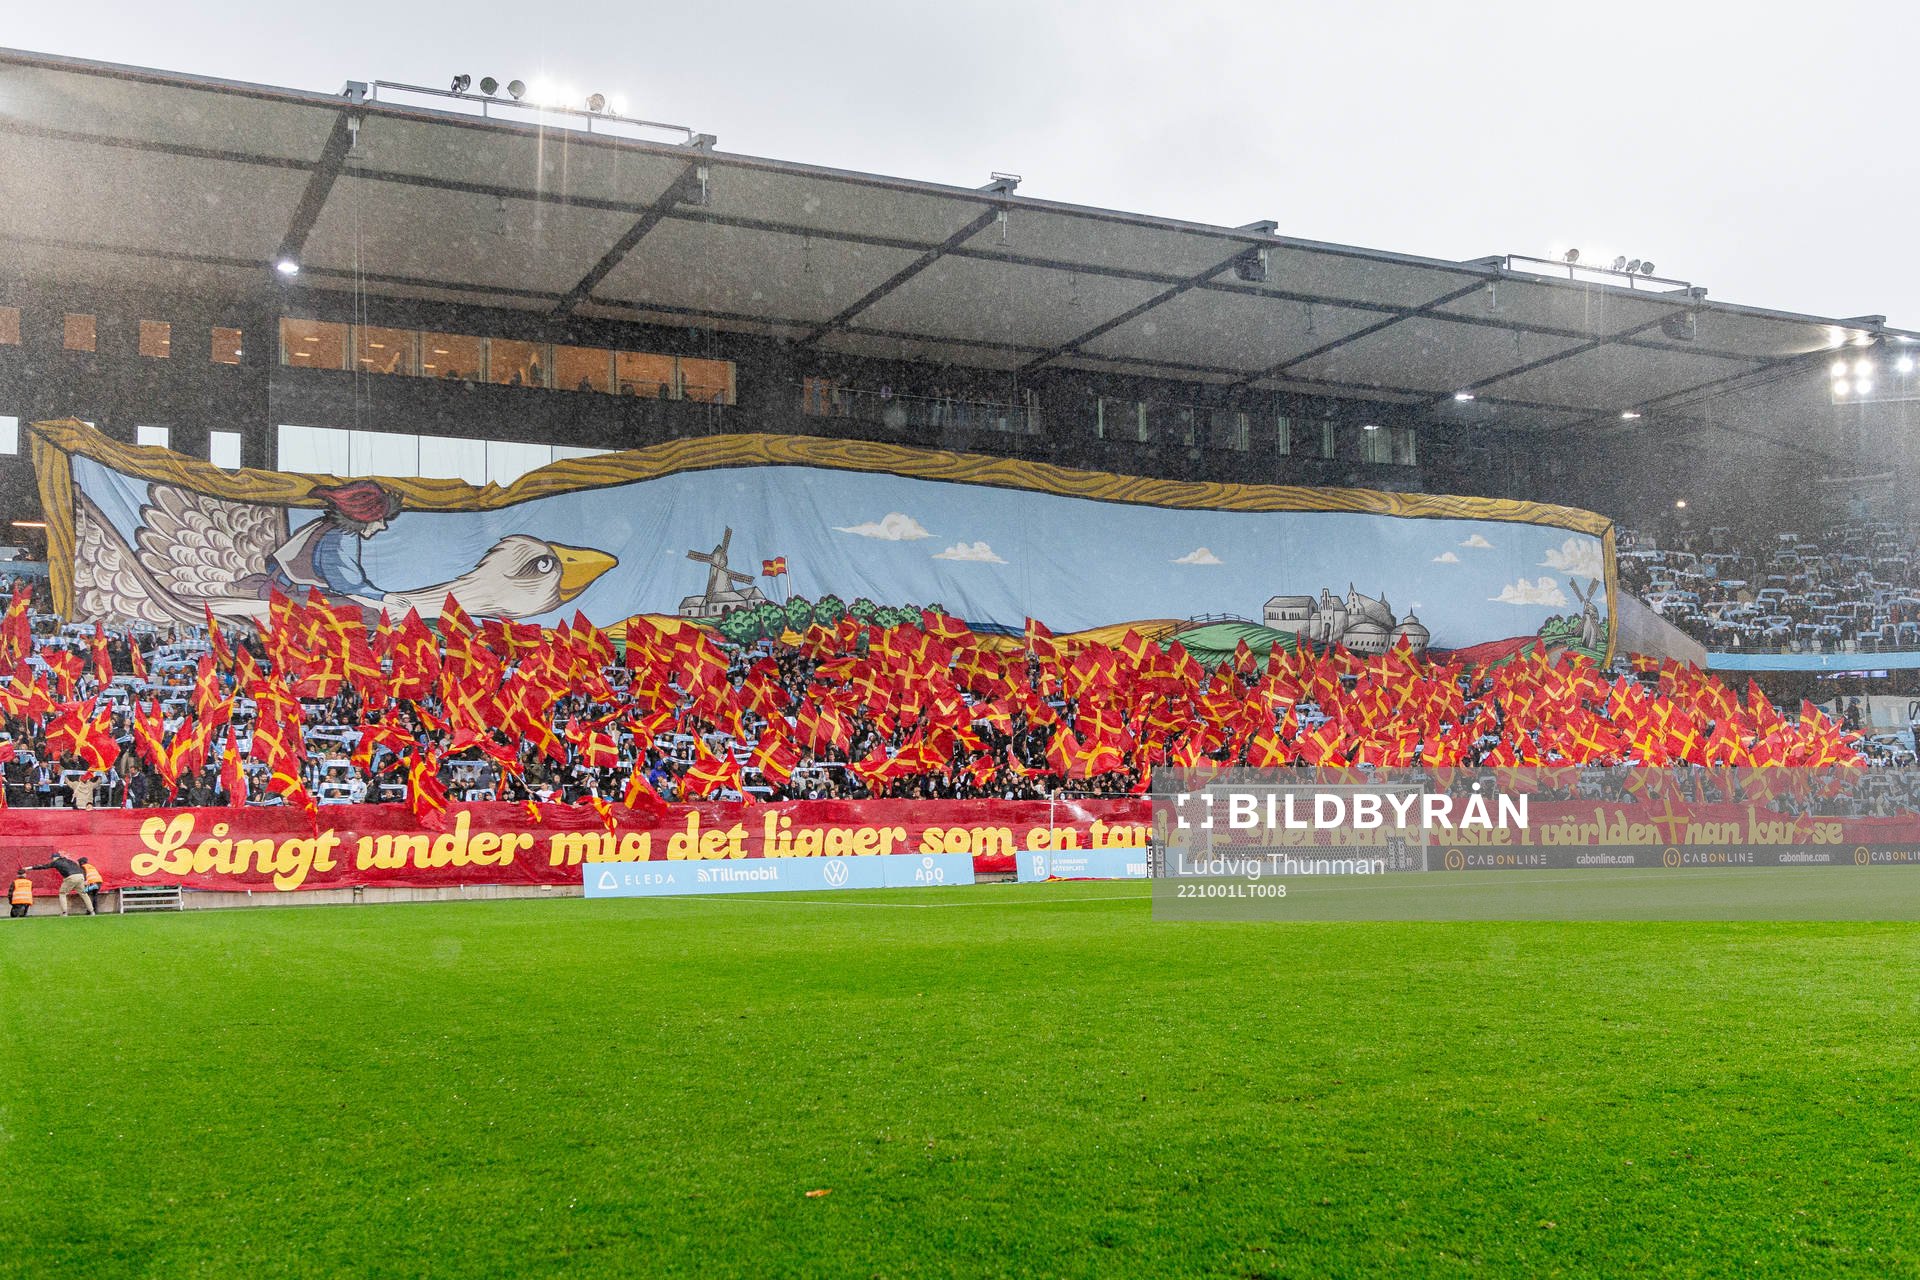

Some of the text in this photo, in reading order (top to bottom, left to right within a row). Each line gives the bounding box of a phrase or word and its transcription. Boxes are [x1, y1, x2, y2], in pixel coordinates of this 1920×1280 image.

[131, 813, 341, 891] Långt
[356, 810, 535, 870] under
[667, 810, 749, 861] det
[763, 810, 907, 858] ligger
[919, 827, 1018, 857] som
[1026, 826, 1083, 851] en
[1540, 807, 1665, 846] världen
[1156, 845, 1165, 879] SELECT
[1467, 854, 1547, 865] CABONLINE
[1576, 853, 1635, 865] cabonline.com
[1683, 852, 1754, 863] CABONLINE
[1779, 851, 1830, 863] cabonline.com
[624, 873, 676, 886] ELEDA
[709, 866, 778, 883] Tillmobil
[915, 867, 944, 884] ApQ
